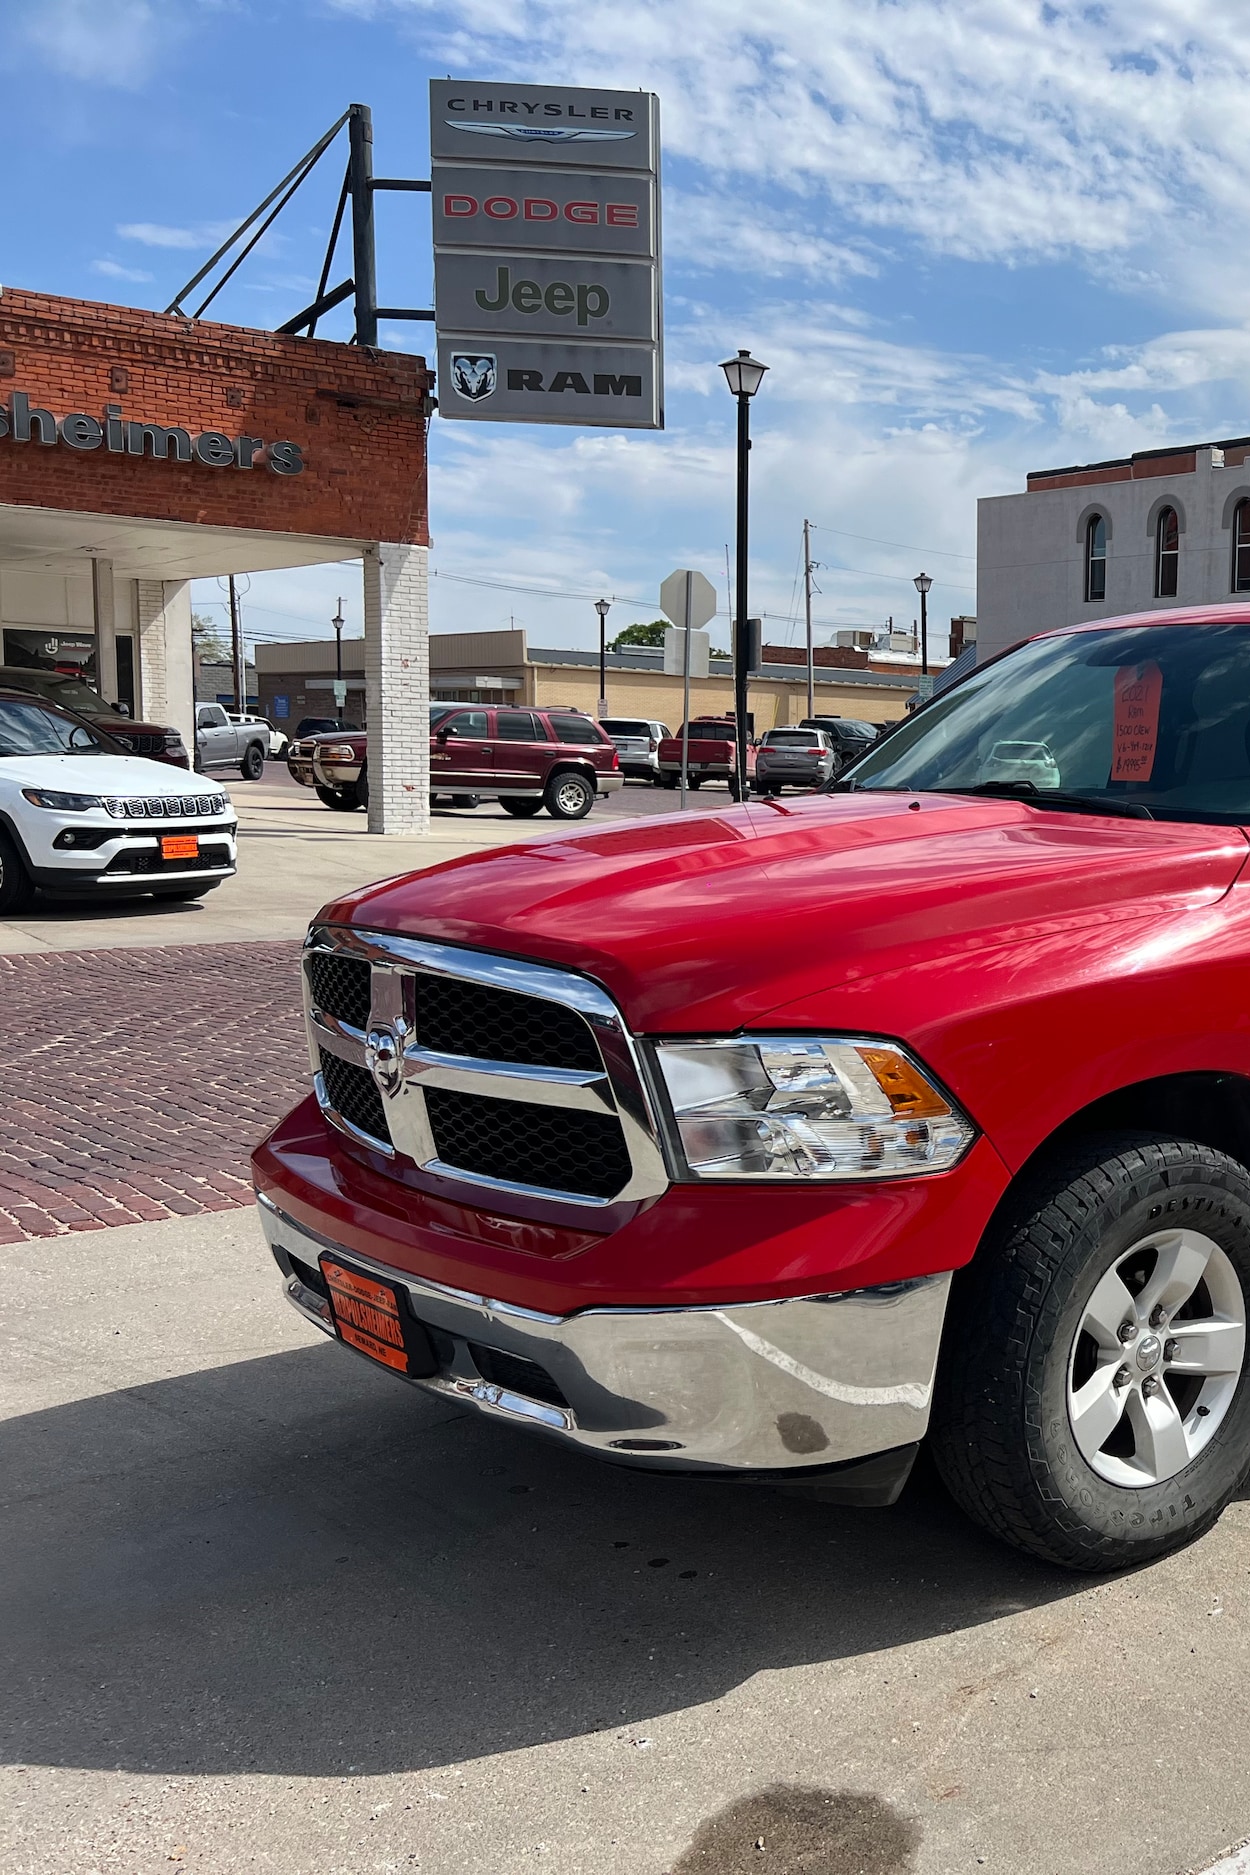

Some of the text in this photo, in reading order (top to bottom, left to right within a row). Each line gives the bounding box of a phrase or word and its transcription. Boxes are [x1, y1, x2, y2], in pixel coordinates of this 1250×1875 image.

[447, 98, 635, 122] CHRYSLER
[443, 194, 639, 228] DODGE
[475, 266, 610, 326] Jeep
[507, 369, 642, 397] RAM
[0, 391, 304, 475] heimers
[1116, 723, 1132, 737] 1500
